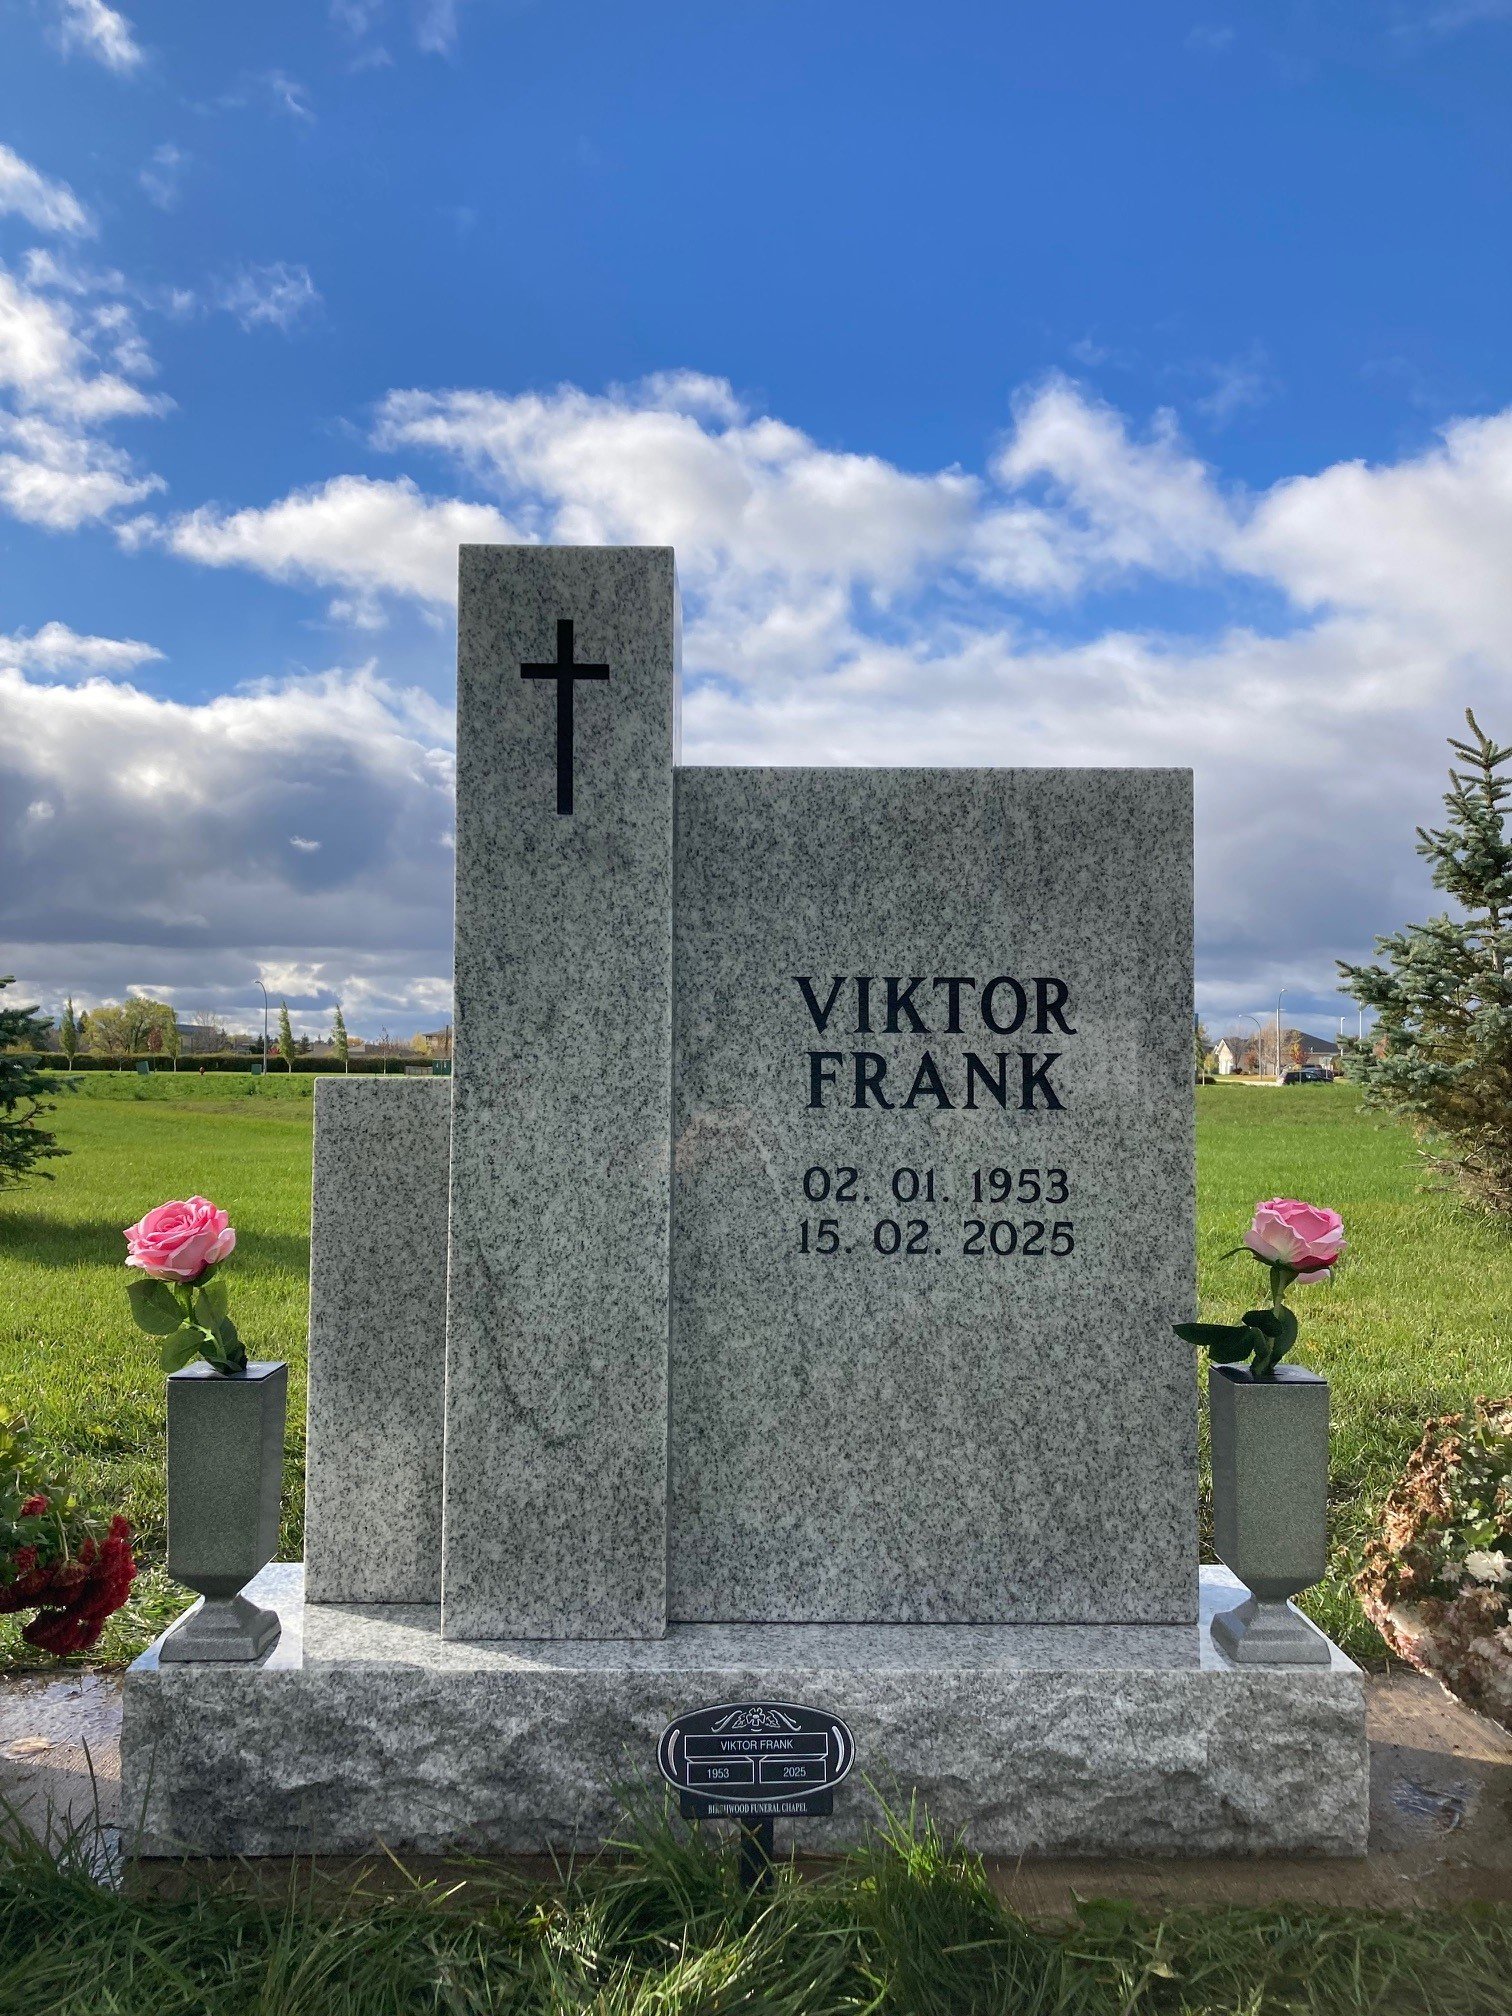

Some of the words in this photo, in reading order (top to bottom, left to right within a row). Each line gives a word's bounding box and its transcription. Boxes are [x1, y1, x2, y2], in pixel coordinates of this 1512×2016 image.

[792, 975, 1078, 1036] VIKTOR
[804, 1050, 1068, 1111] FRANK
[803, 1166, 870, 1204] 02.
[892, 1167, 950, 1203] 01.
[972, 1168, 1070, 1204] 1953
[798, 1218, 852, 1255] 15.
[873, 1219, 942, 1256] 02.
[963, 1220, 1075, 1257] 2025
[720, 1740, 757, 1751] VIKTOR
[759, 1739, 794, 1750] FRANK
[706, 1768, 730, 1779] 1953
[783, 1766, 807, 1778] 2025
[750, 1803, 780, 1814] FUNERAL
[781, 1802, 808, 1813] CHAPEL
